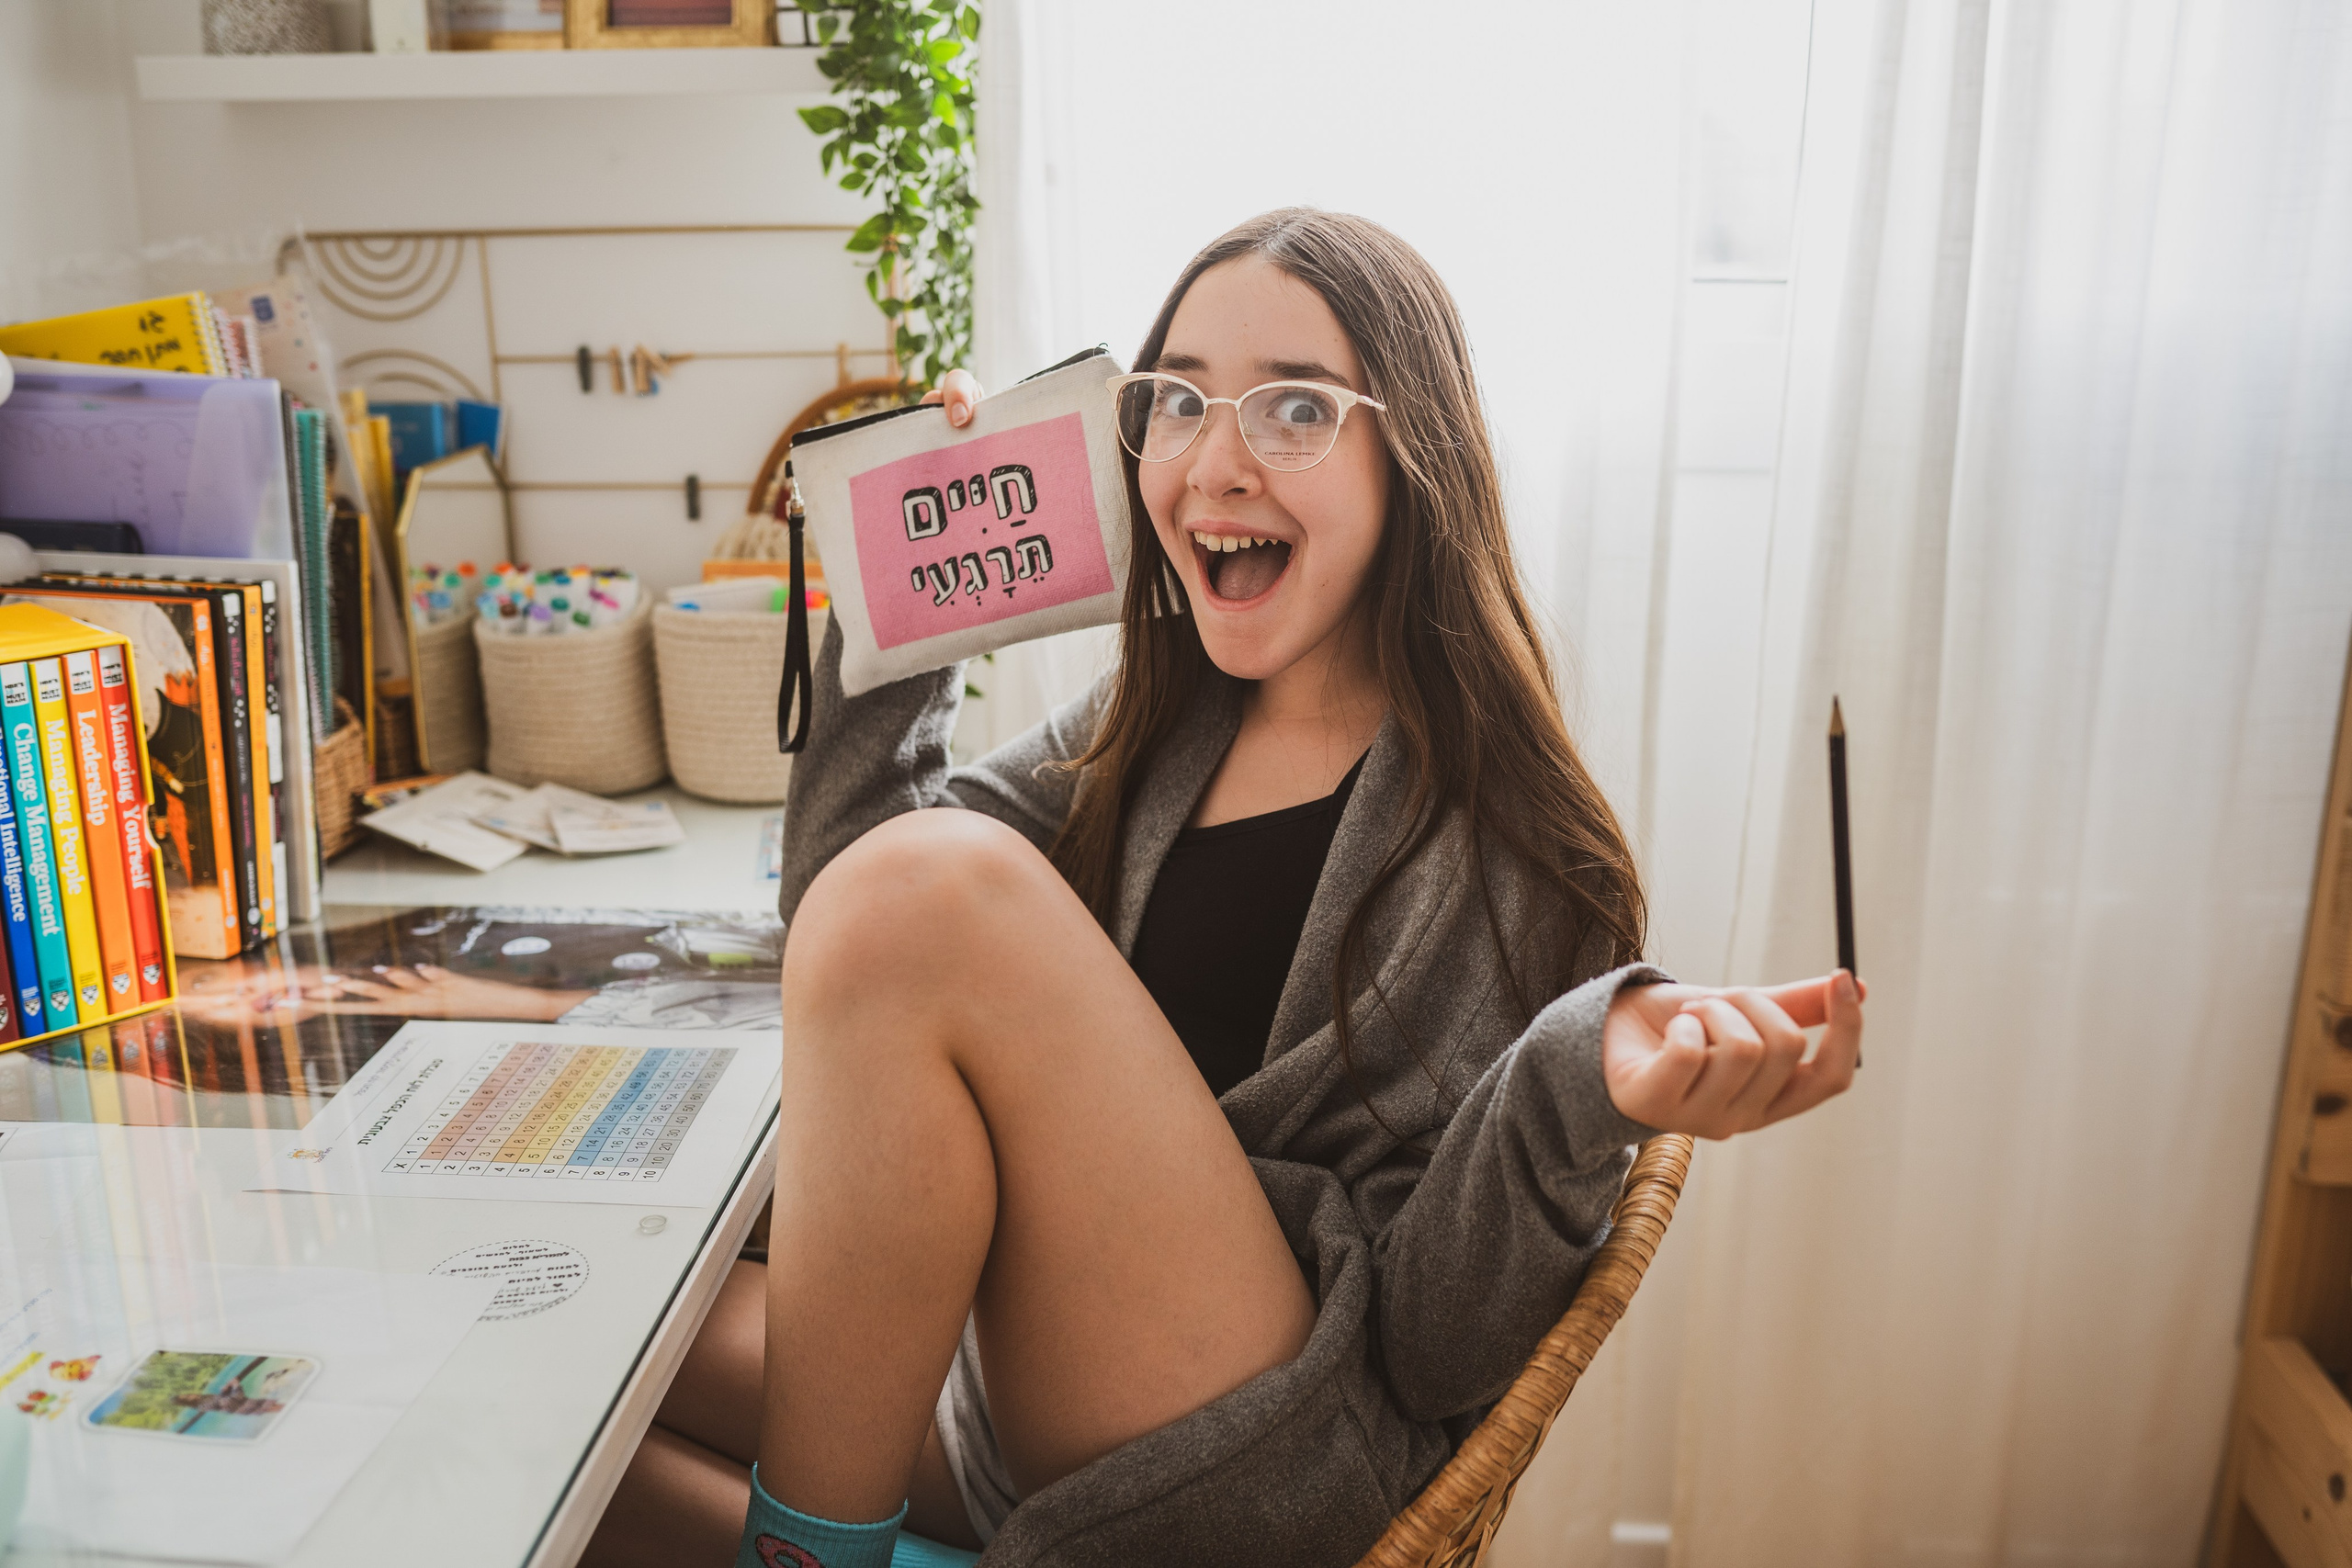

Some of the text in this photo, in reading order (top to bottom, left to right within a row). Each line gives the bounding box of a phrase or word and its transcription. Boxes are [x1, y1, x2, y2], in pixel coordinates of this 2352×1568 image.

[78, 710, 107, 826] Leadership
[108, 703, 136, 803] Managing
[13, 723, 61, 936] Change Management
[46, 719, 85, 895] Managing People
[121, 804, 153, 890] Yourself
[0, 821, 26, 922] Intelligence
[357, 1116, 391, 1144] צבעונית
[382, 1094, 411, 1112] הכפל
